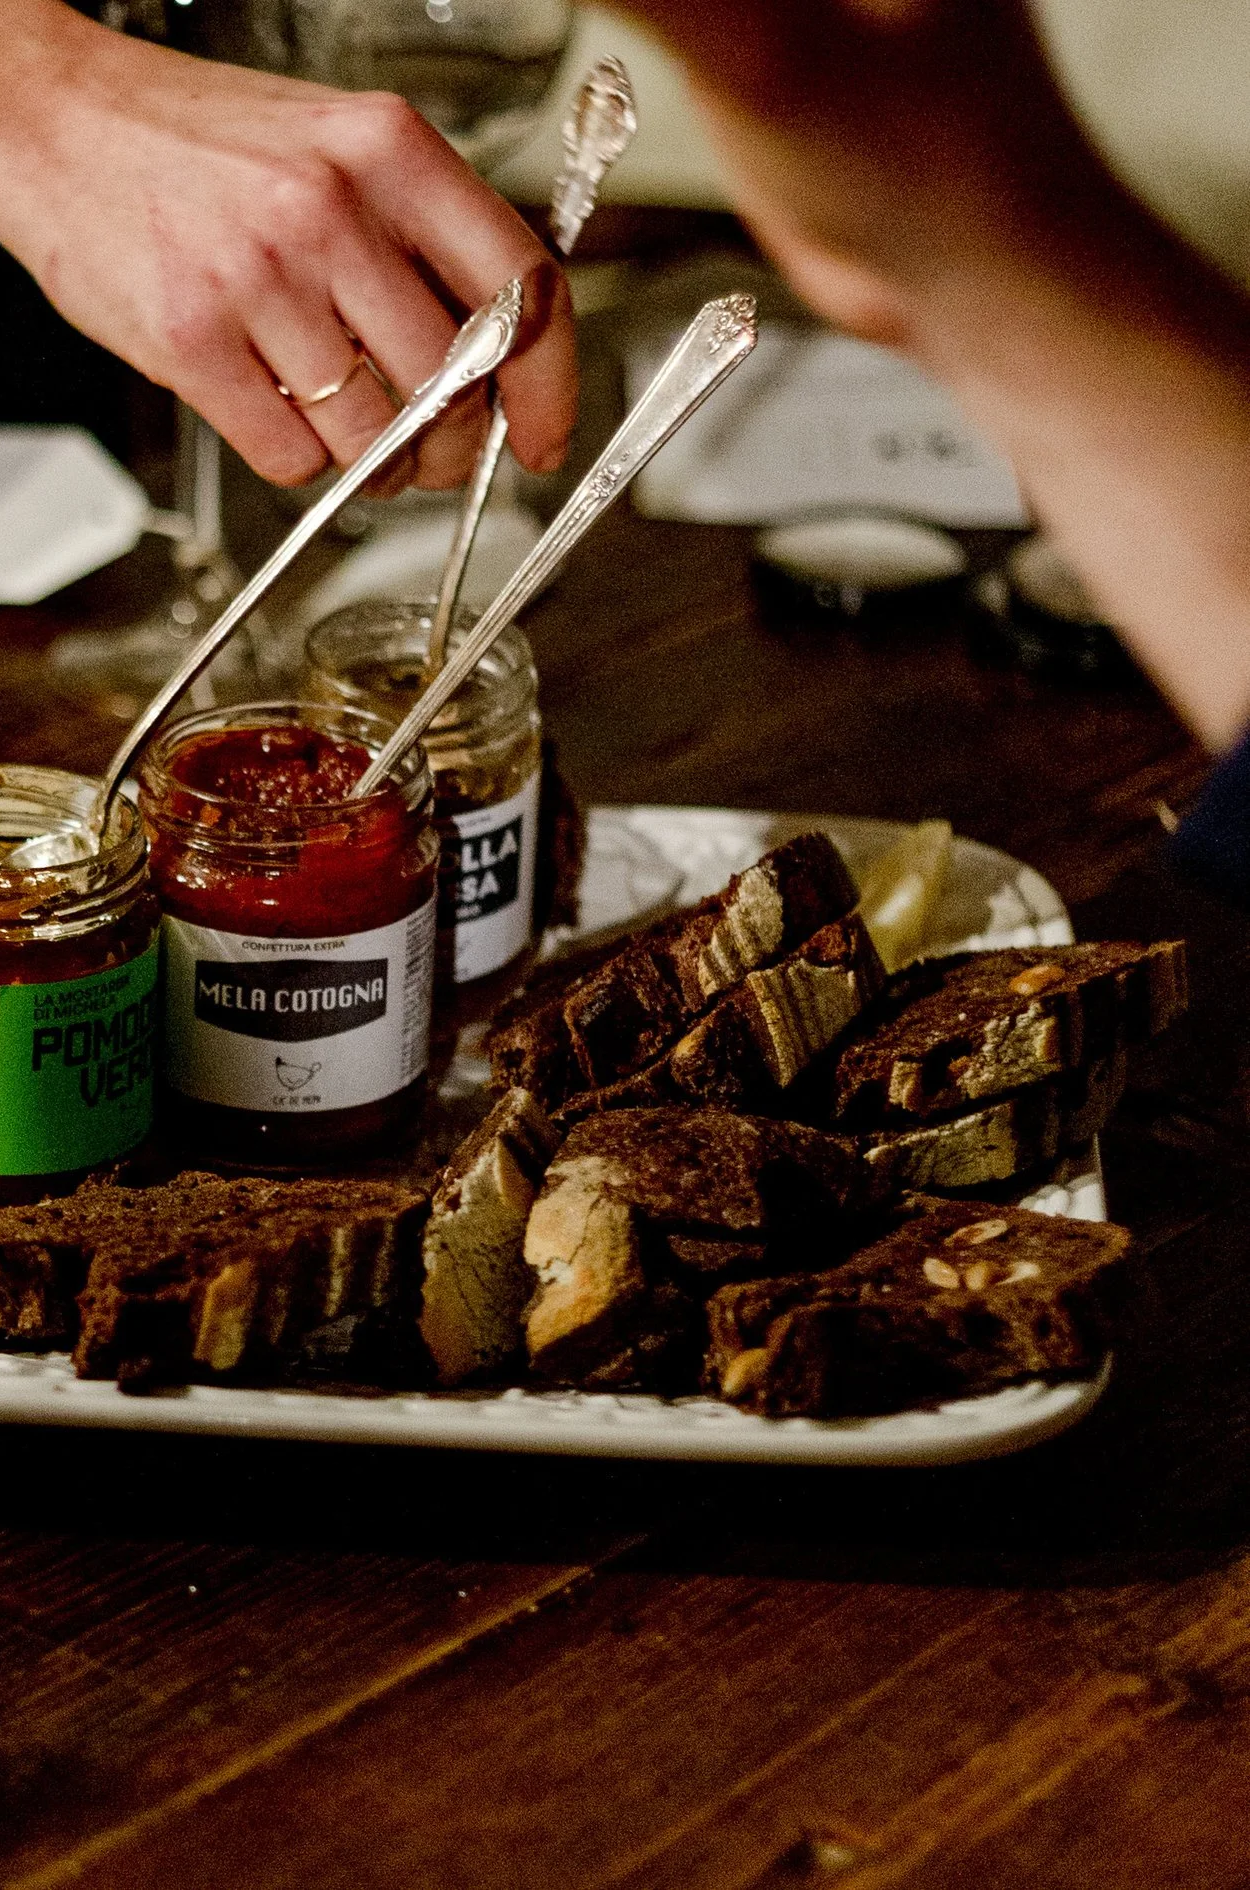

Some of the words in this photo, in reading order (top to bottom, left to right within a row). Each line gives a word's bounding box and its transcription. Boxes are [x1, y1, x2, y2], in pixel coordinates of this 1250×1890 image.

[461, 829, 517, 874] LLA
[456, 869, 499, 904] SA
[242, 940, 311, 953] CONFETTURA
[314, 939, 346, 952] EXTRA
[199, 978, 267, 1012] MELA
[274, 977, 384, 1013] COTOGNA
[81, 1046, 154, 1108] VER
